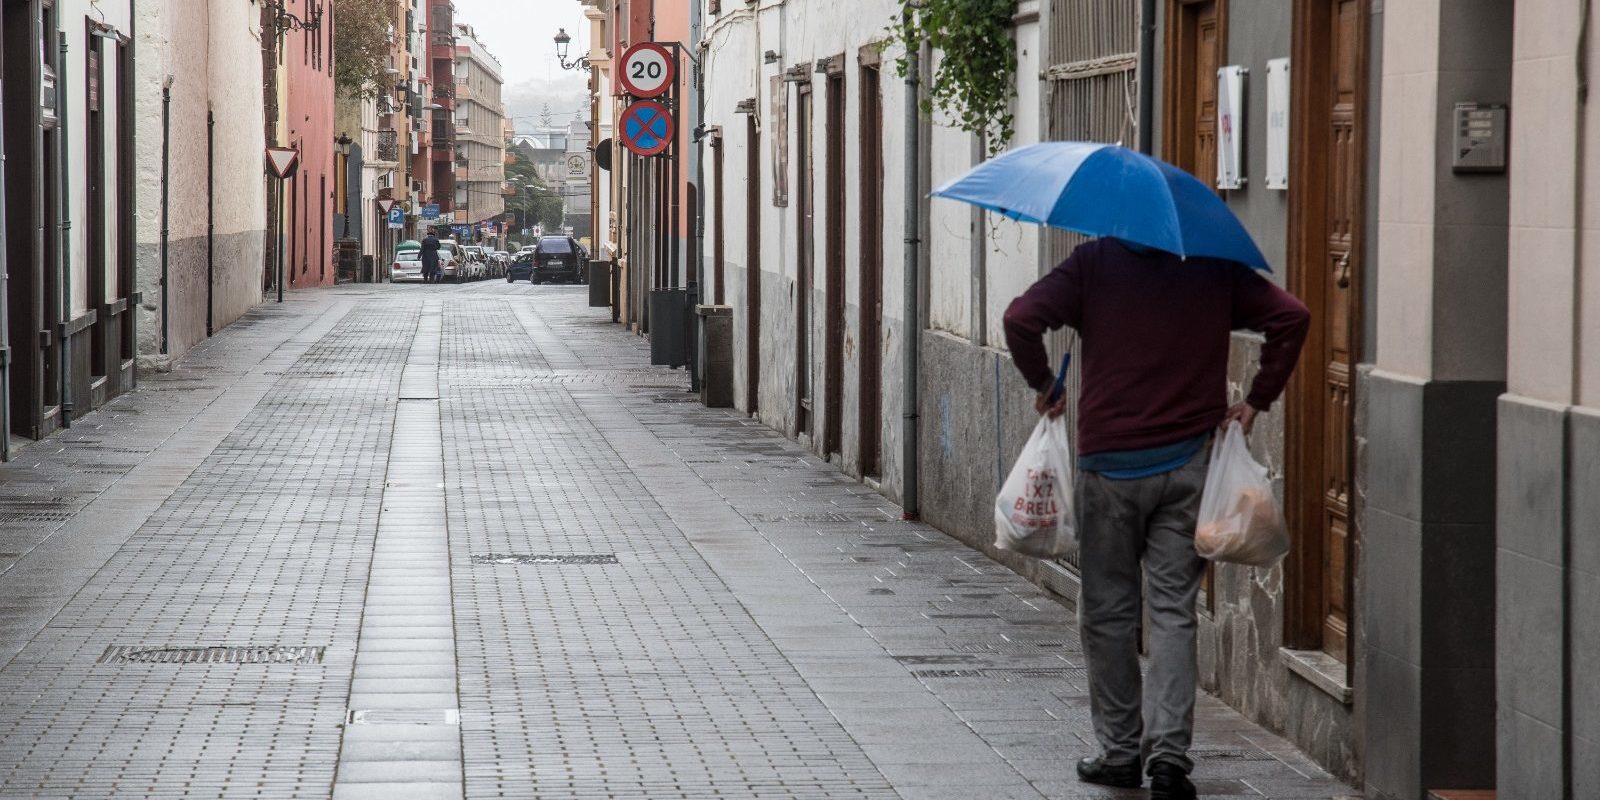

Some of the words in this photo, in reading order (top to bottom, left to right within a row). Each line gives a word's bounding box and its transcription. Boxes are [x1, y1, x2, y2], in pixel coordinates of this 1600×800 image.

[632, 61, 662, 79] 20
[390, 210, 400, 221] P
[462, 229, 469, 237] P
